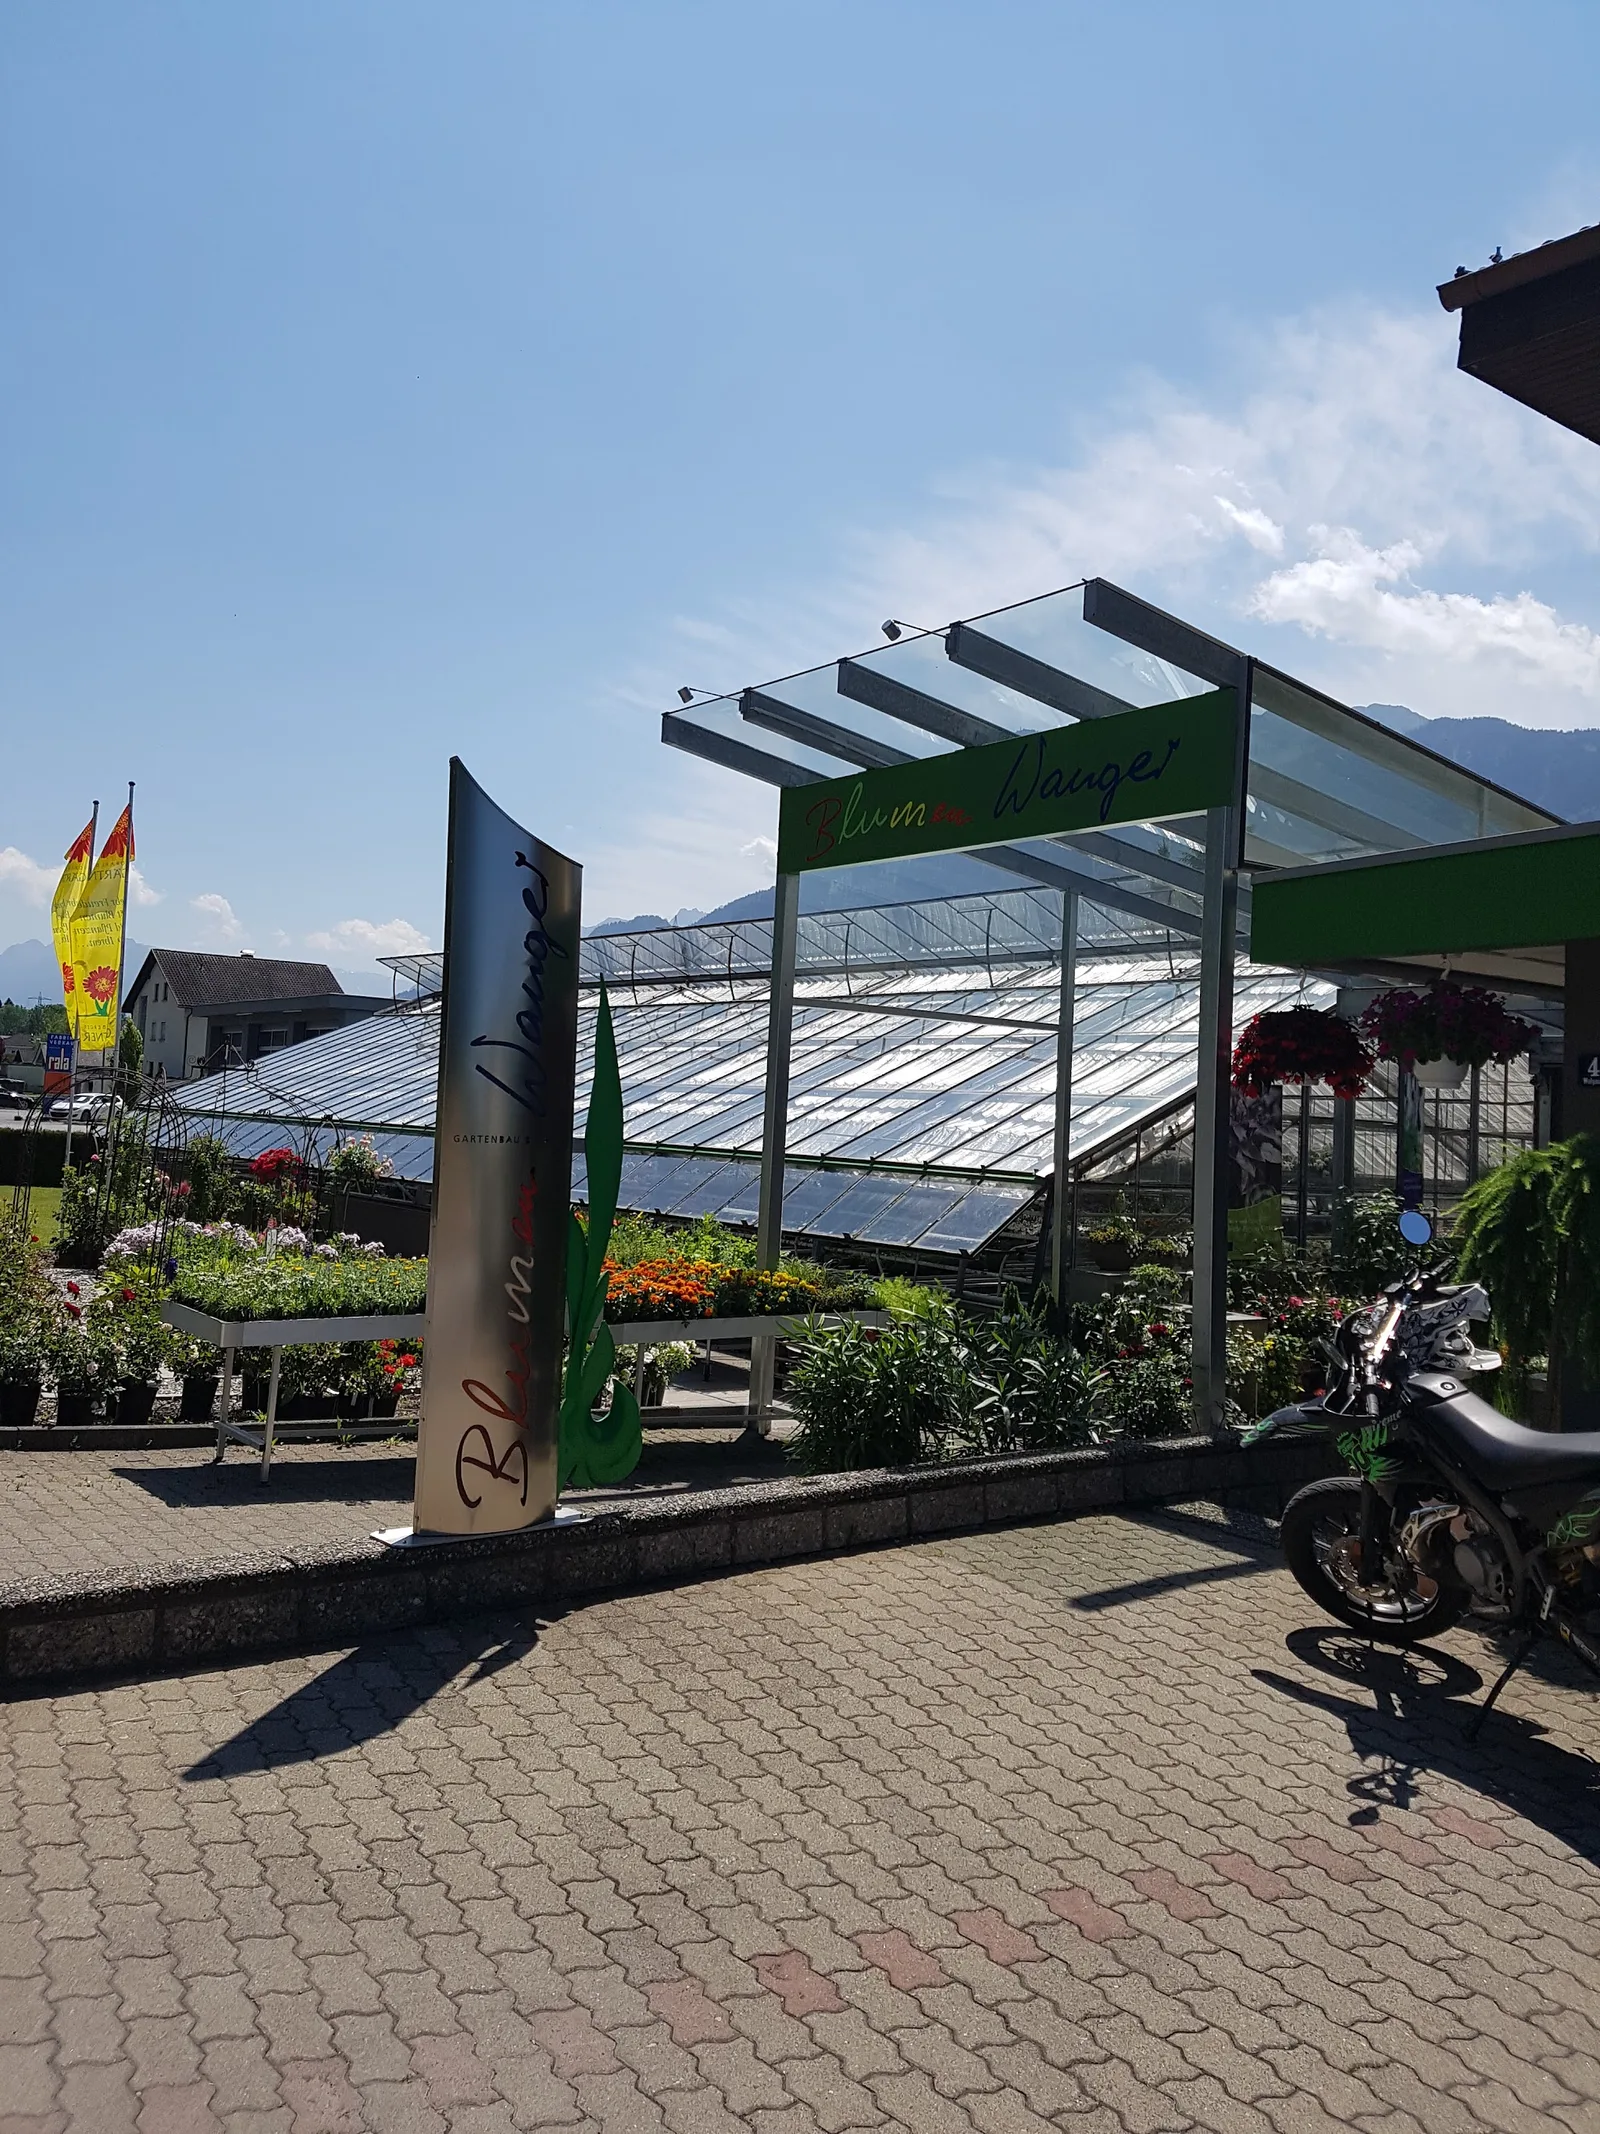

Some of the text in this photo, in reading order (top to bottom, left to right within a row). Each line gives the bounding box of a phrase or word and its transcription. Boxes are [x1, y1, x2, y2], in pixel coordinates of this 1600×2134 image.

[806, 734, 1182, 862] Blumen Wanger
[48, 1047, 70, 1070] rala
[453, 1134, 520, 1144] GARTENBAU
[455, 1166, 538, 1509] Blumen
